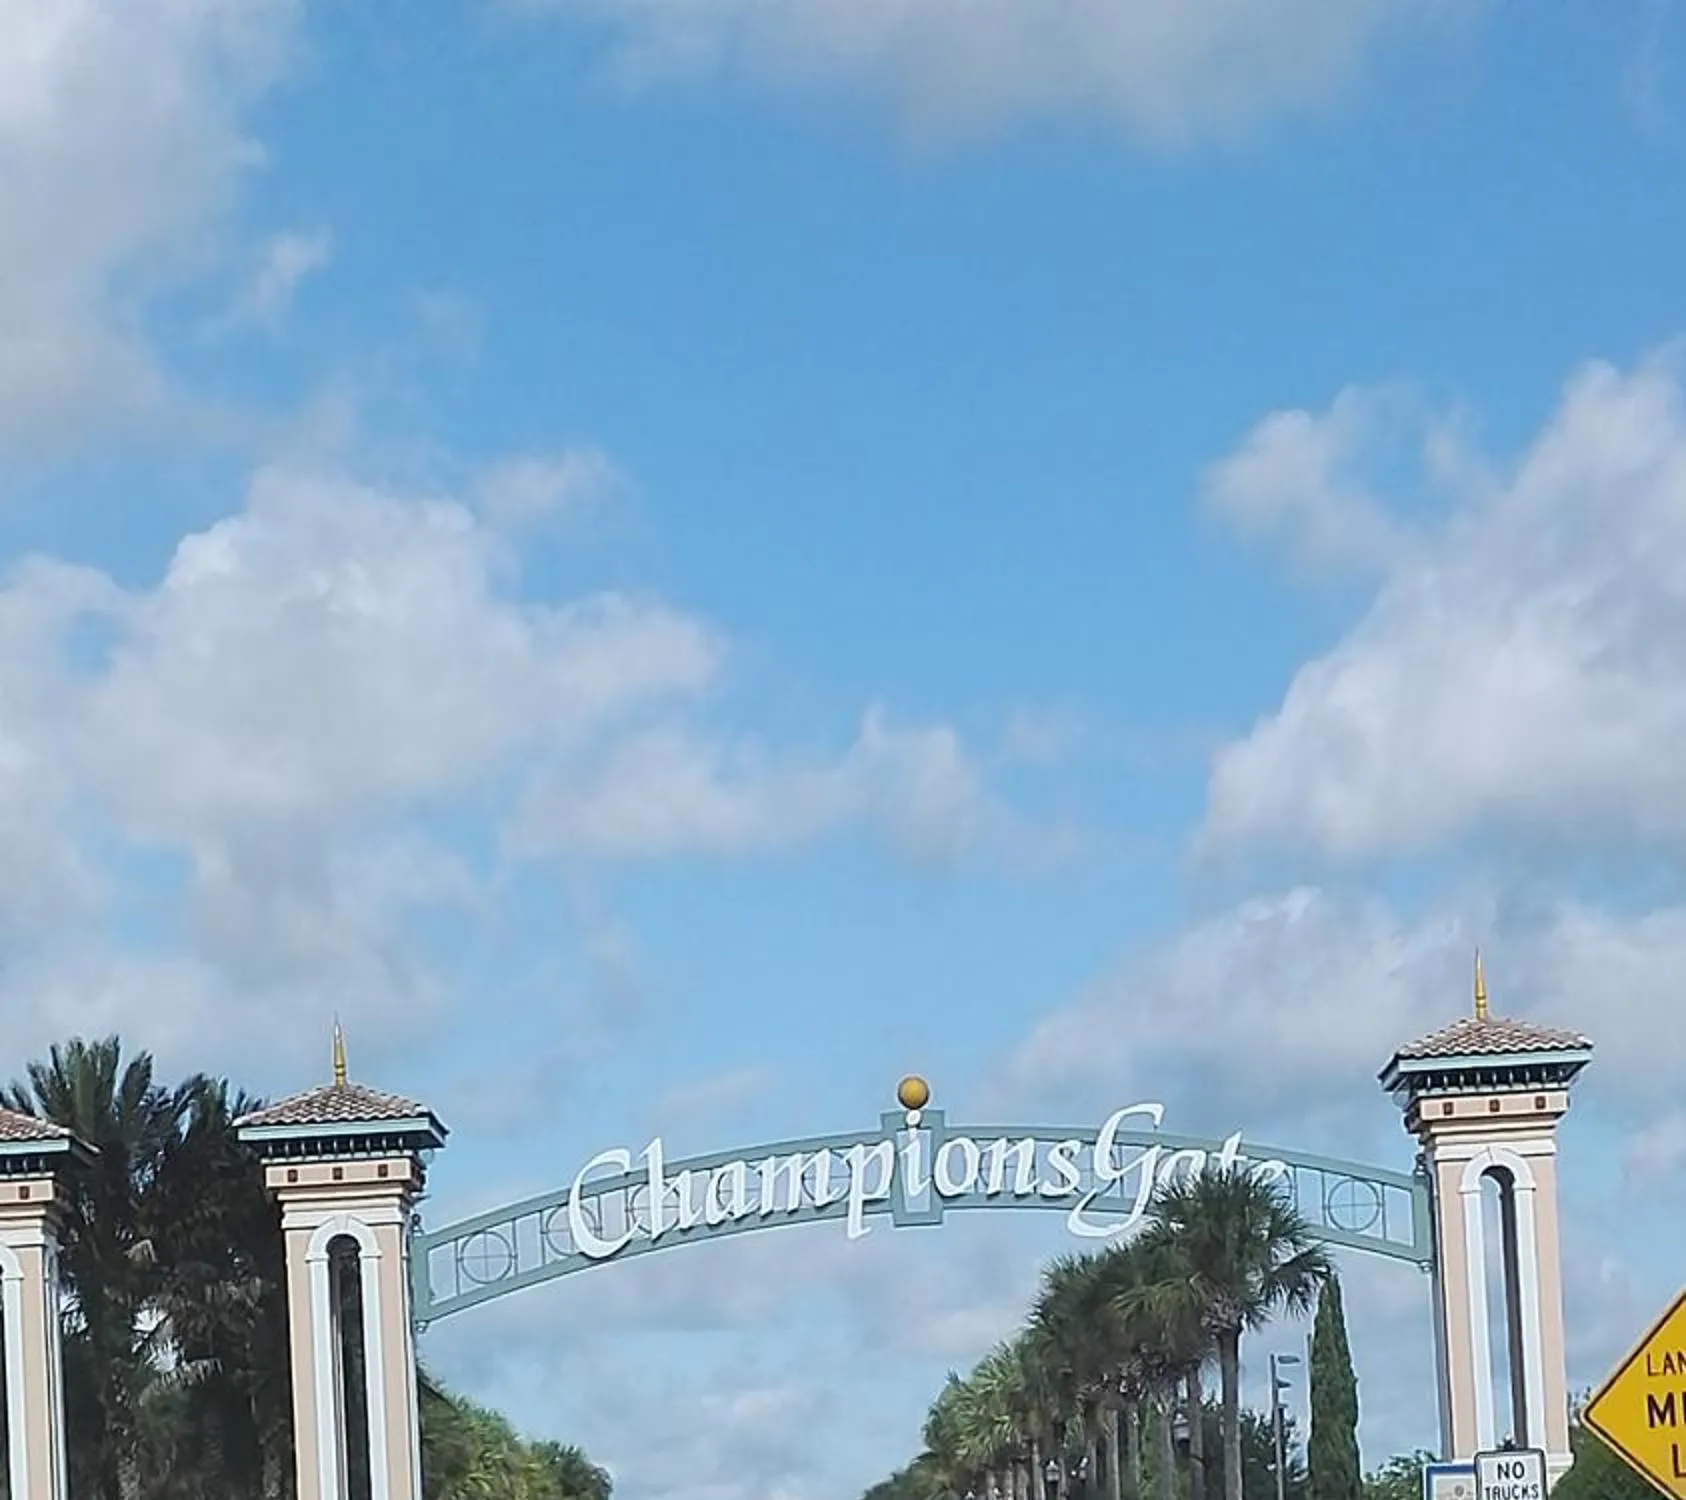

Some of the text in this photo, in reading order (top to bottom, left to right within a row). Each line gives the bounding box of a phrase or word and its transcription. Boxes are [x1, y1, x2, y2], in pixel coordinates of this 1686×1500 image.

[1647, 1391, 1686, 1428] M
[1497, 1461, 1525, 1480] NO
[1485, 1484, 1539, 1500] TRUCKS
